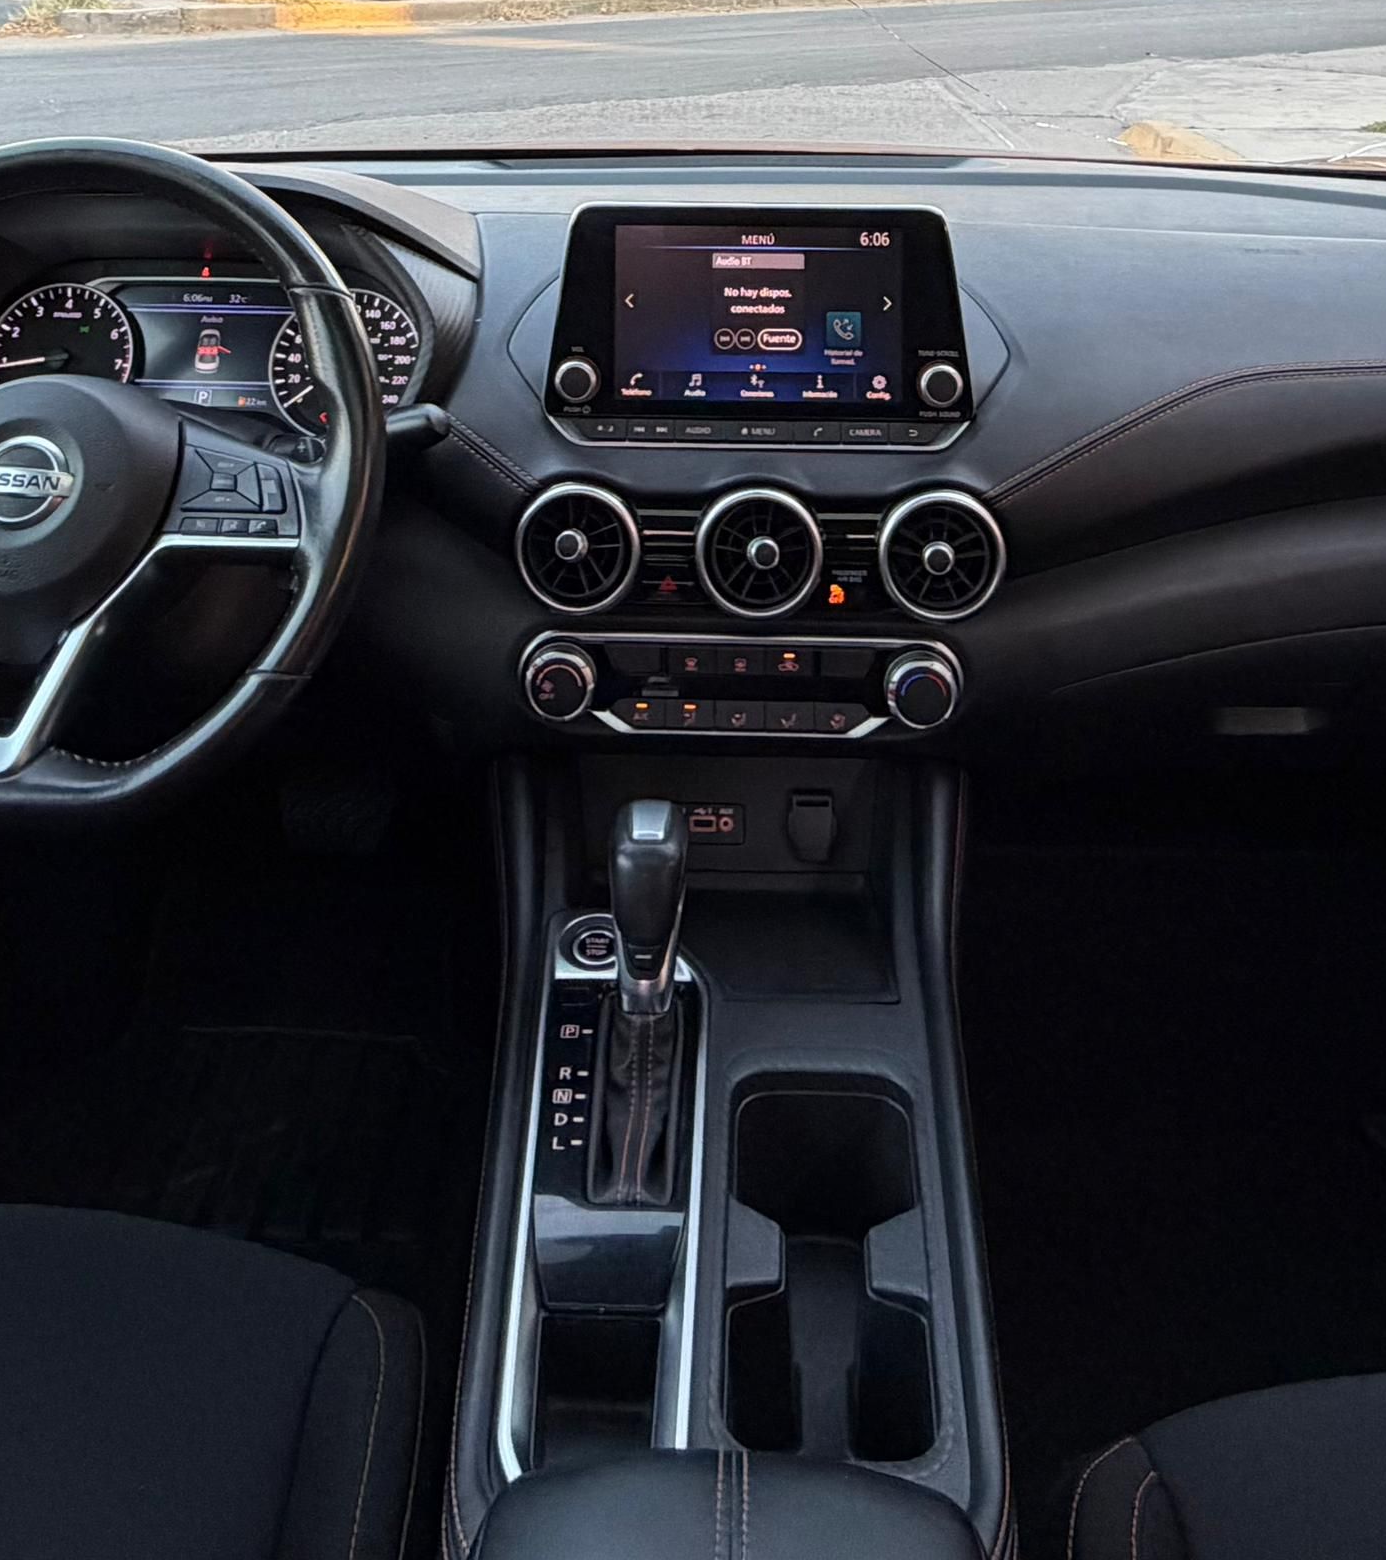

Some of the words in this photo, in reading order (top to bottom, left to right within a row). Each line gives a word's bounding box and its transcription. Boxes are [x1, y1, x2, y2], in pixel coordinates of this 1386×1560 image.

[741, 233, 775, 246] MENÚ
[859, 231, 891, 247] 6:06
[715, 255, 741, 267] Audio
[741, 256, 753, 267] BT
[723, 287, 740, 297] No
[740, 286, 759, 300] hay
[759, 286, 793, 300] dispos.
[64, 298, 74, 309] 4
[730, 303, 786, 315] conectados
[35, 306, 45, 318] 3
[93, 307, 102, 319] 5
[365, 309, 382, 319] 140
[380, 320, 396, 330] 160
[11, 326, 21, 338] 2
[110, 329, 119, 340] 6
[390, 336, 406, 346] 180
[763, 333, 797, 344] Fuente
[287, 353, 302, 364] 40
[394, 355, 411, 365] 200
[114, 359, 123, 371] 7
[287, 373, 301, 384] 20
[391, 375, 409, 385] 220
[198, 390, 209, 404] P
[381, 394, 399, 405] 240
[558, 1066, 572, 1080] R
[553, 1112, 569, 1127] D
[551, 1136, 566, 1150] L
